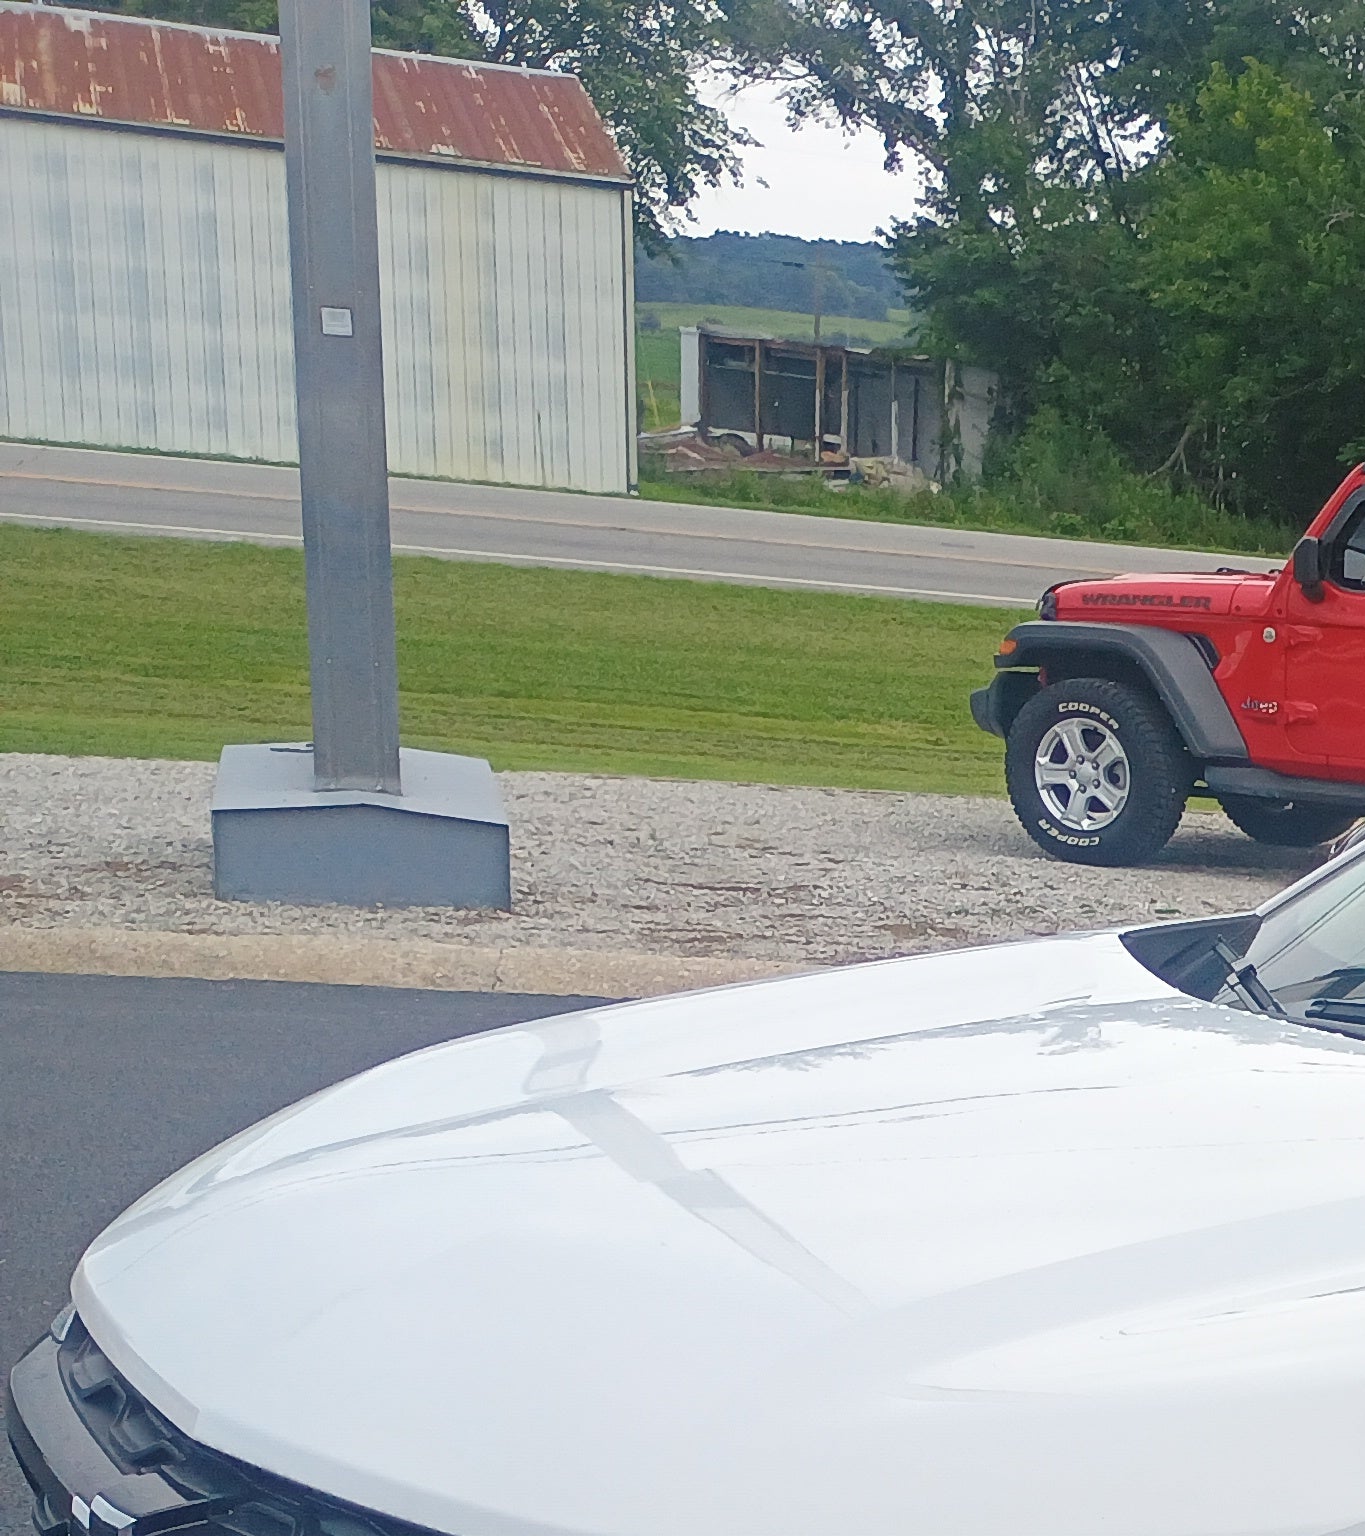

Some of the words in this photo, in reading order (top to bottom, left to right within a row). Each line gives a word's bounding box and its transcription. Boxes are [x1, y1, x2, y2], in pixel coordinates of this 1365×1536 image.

[1082, 593, 1211, 610] WRANGLER
[1058, 701, 1120, 730] COOPER
[1037, 818, 1100, 848] COOPER
